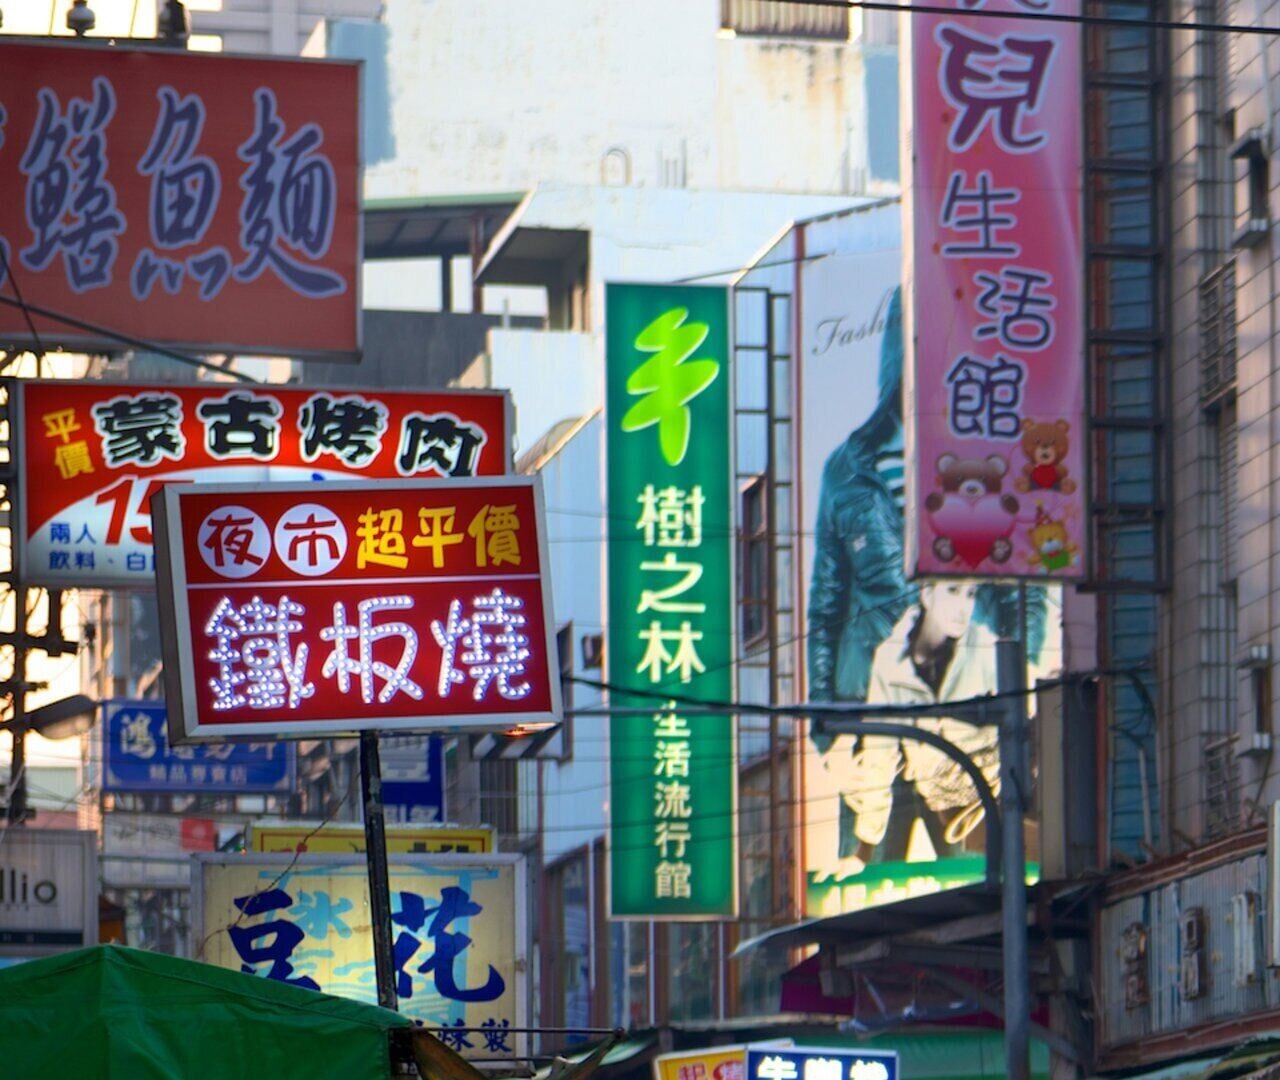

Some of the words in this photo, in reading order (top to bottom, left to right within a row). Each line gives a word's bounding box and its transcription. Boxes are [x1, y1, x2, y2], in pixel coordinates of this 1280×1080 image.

[0, 76, 346, 300] 鱔魚麵
[936, 0, 1058, 442] 兒生活館
[43, 408, 95, 480] 平價
[93, 392, 486, 477] 蒙古烤肉
[50, 552, 156, 571] 飲料、白
[636, 484, 706, 683] 樹之林
[205, 590, 533, 710] 鐵板燒
[229, 886, 505, 1002] 豆花
